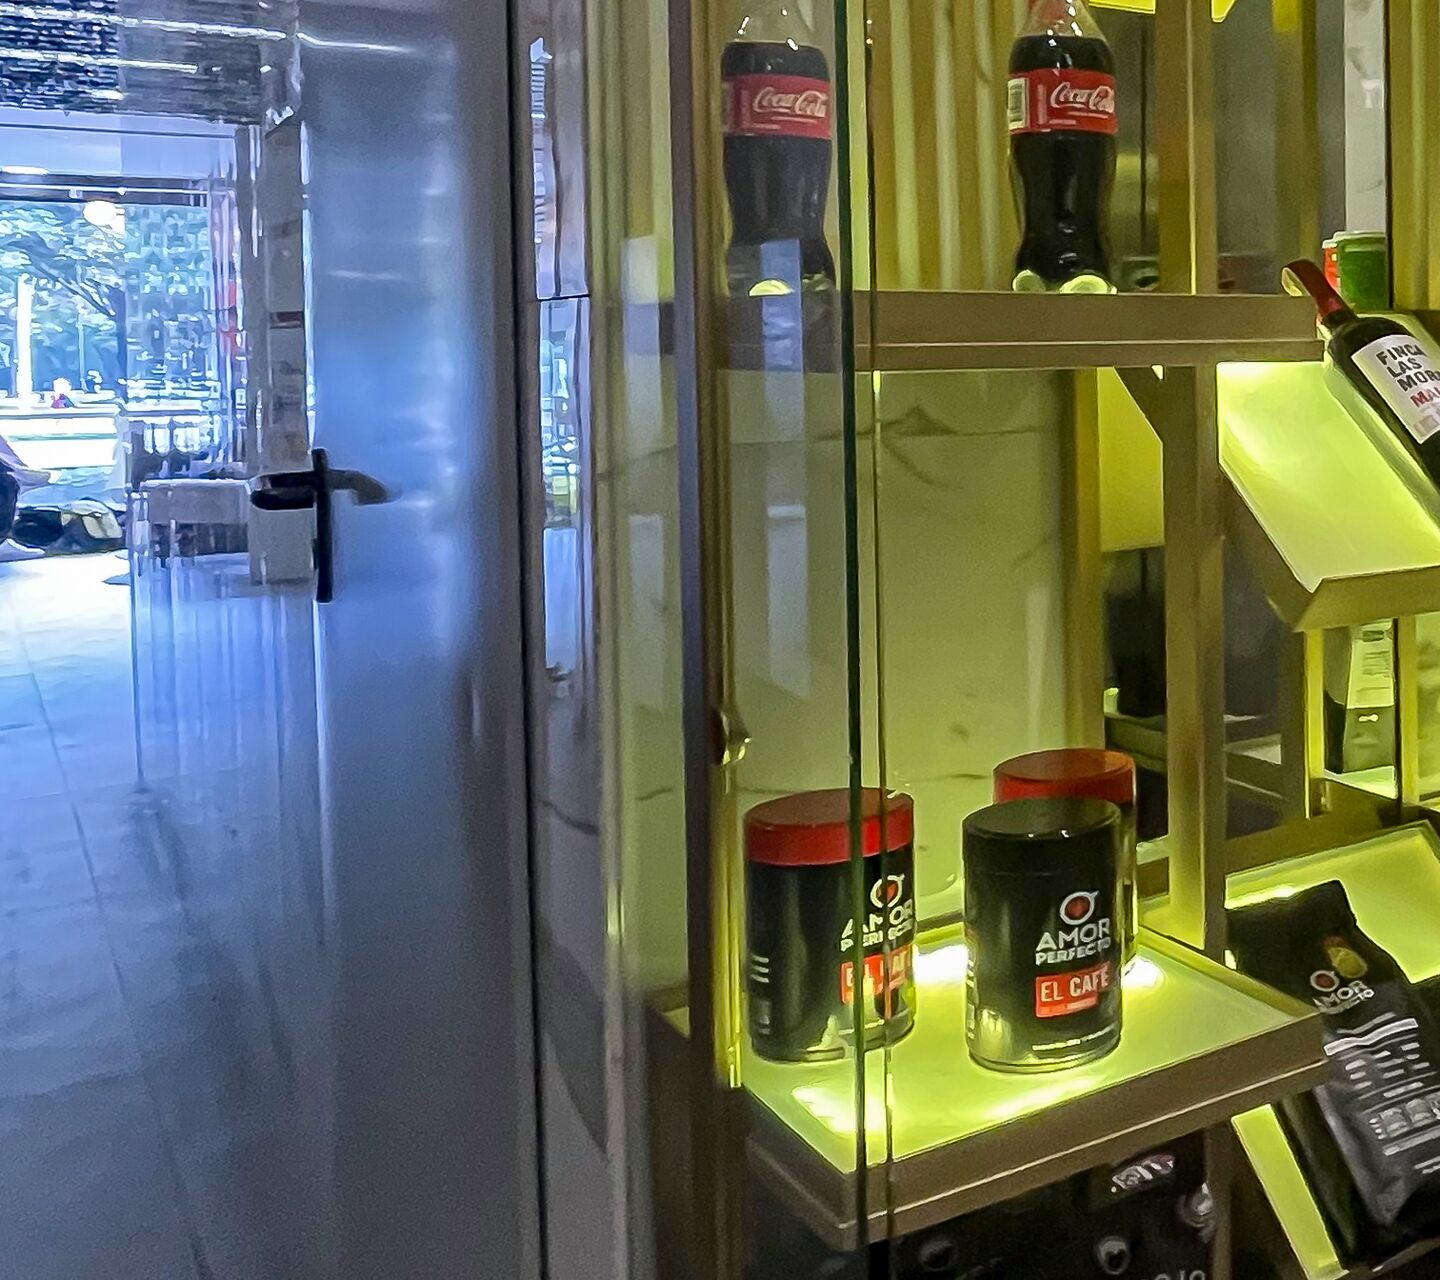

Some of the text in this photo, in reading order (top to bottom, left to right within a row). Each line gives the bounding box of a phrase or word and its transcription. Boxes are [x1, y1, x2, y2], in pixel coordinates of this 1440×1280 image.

[1386, 356, 1423, 378] LAS
[1035, 917, 1111, 952] AMOR
[1040, 980, 1065, 1003] EL
